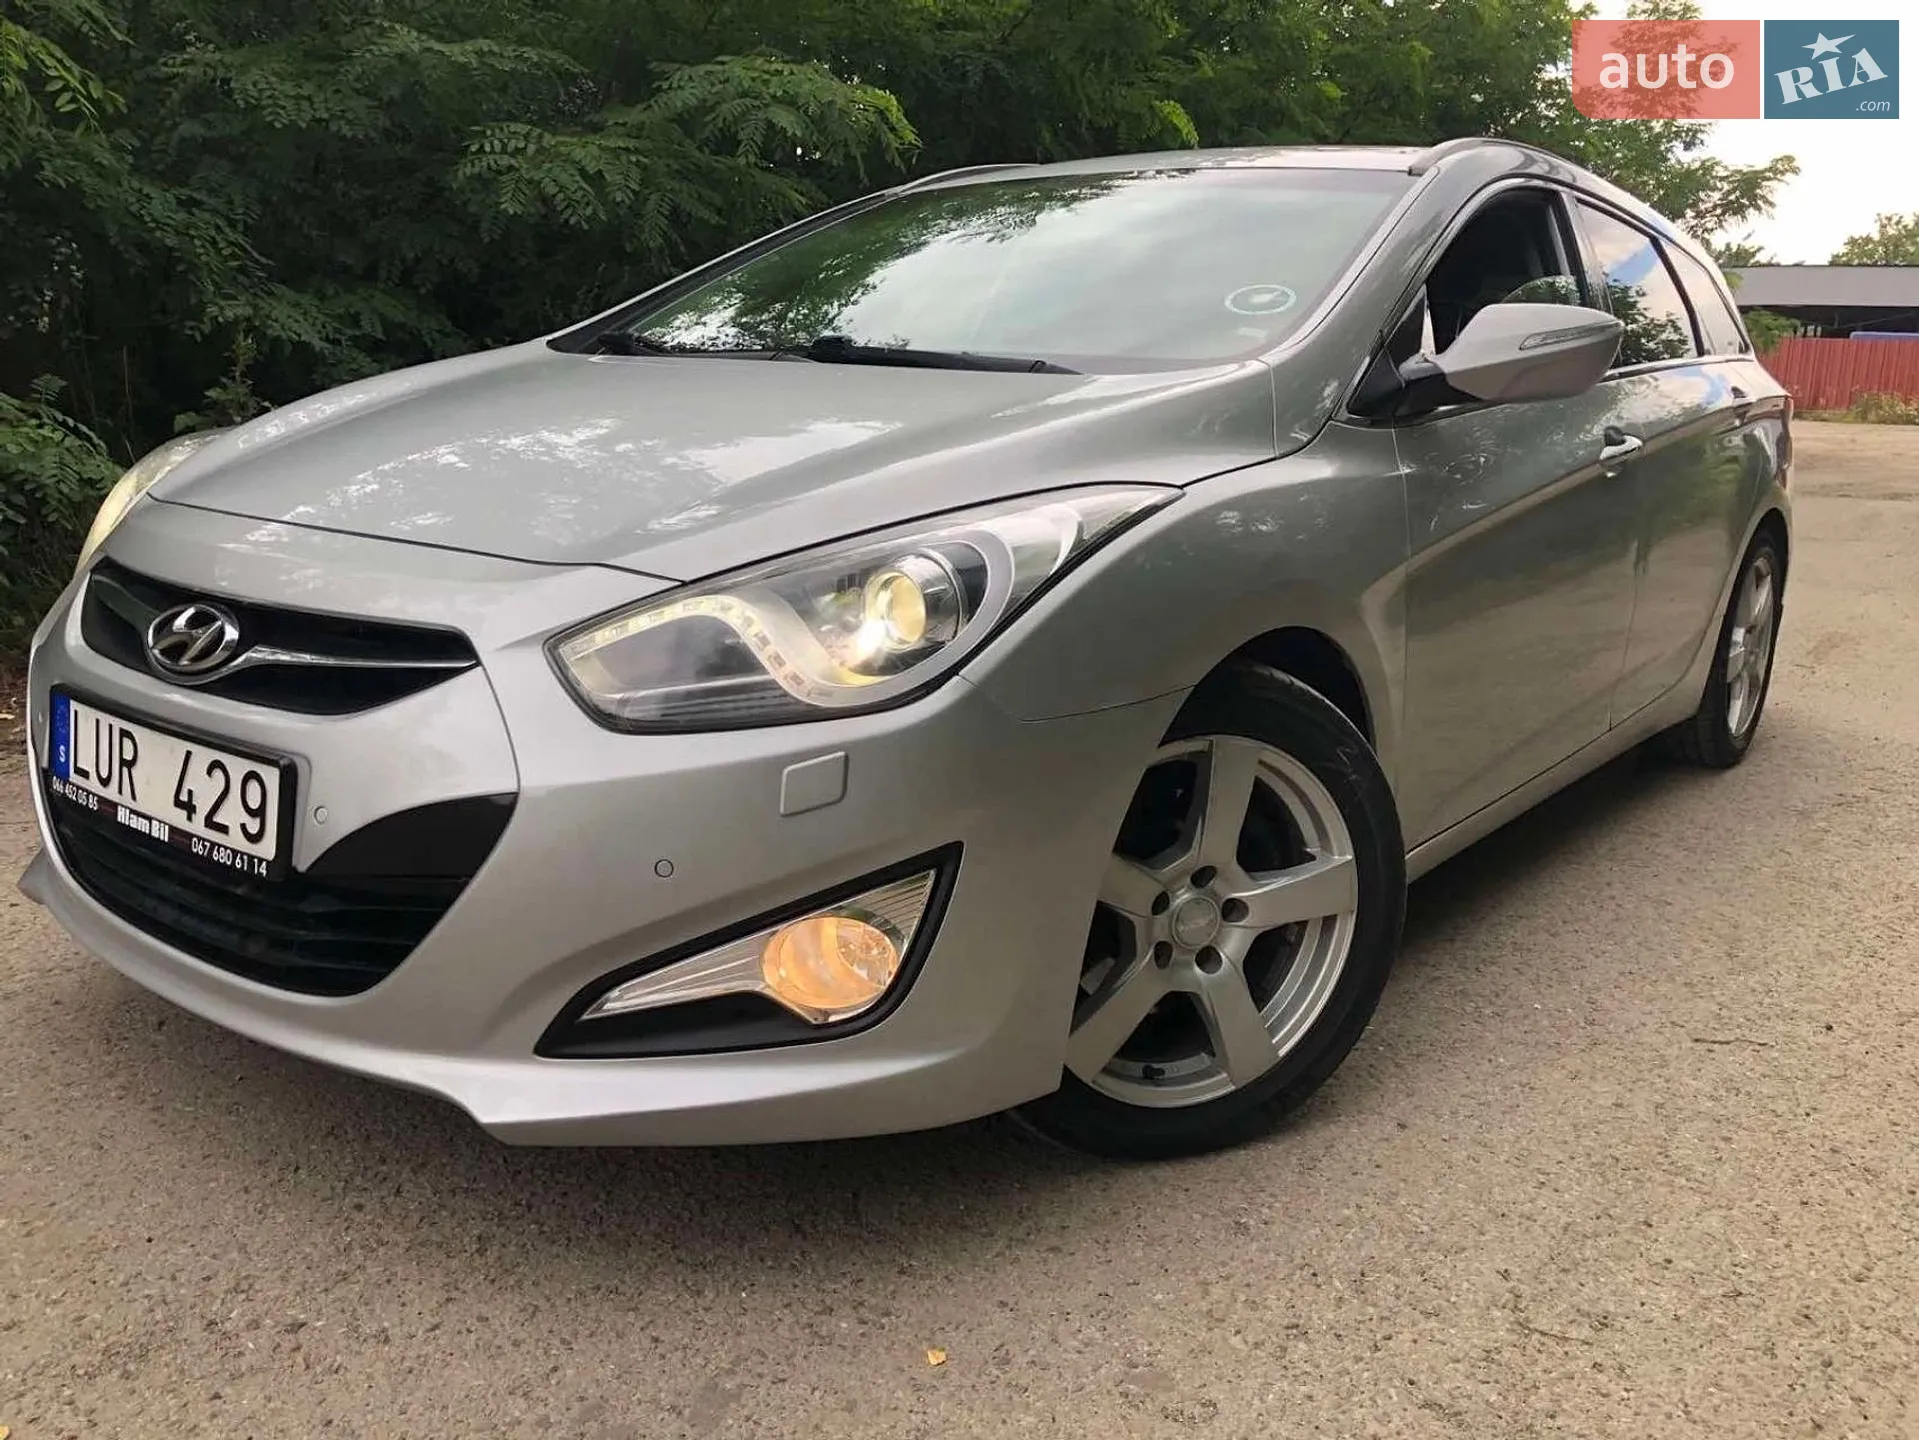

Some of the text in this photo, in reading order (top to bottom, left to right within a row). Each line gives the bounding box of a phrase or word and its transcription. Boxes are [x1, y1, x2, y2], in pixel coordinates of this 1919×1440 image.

[59, 744, 66, 763] S
[73, 709, 268, 845] LUR 429
[65, 783, 77, 801] 452
[88, 794, 99, 811] 85
[151, 819, 169, 843] Bil
[191, 837, 268, 877] 067 680 61 14
